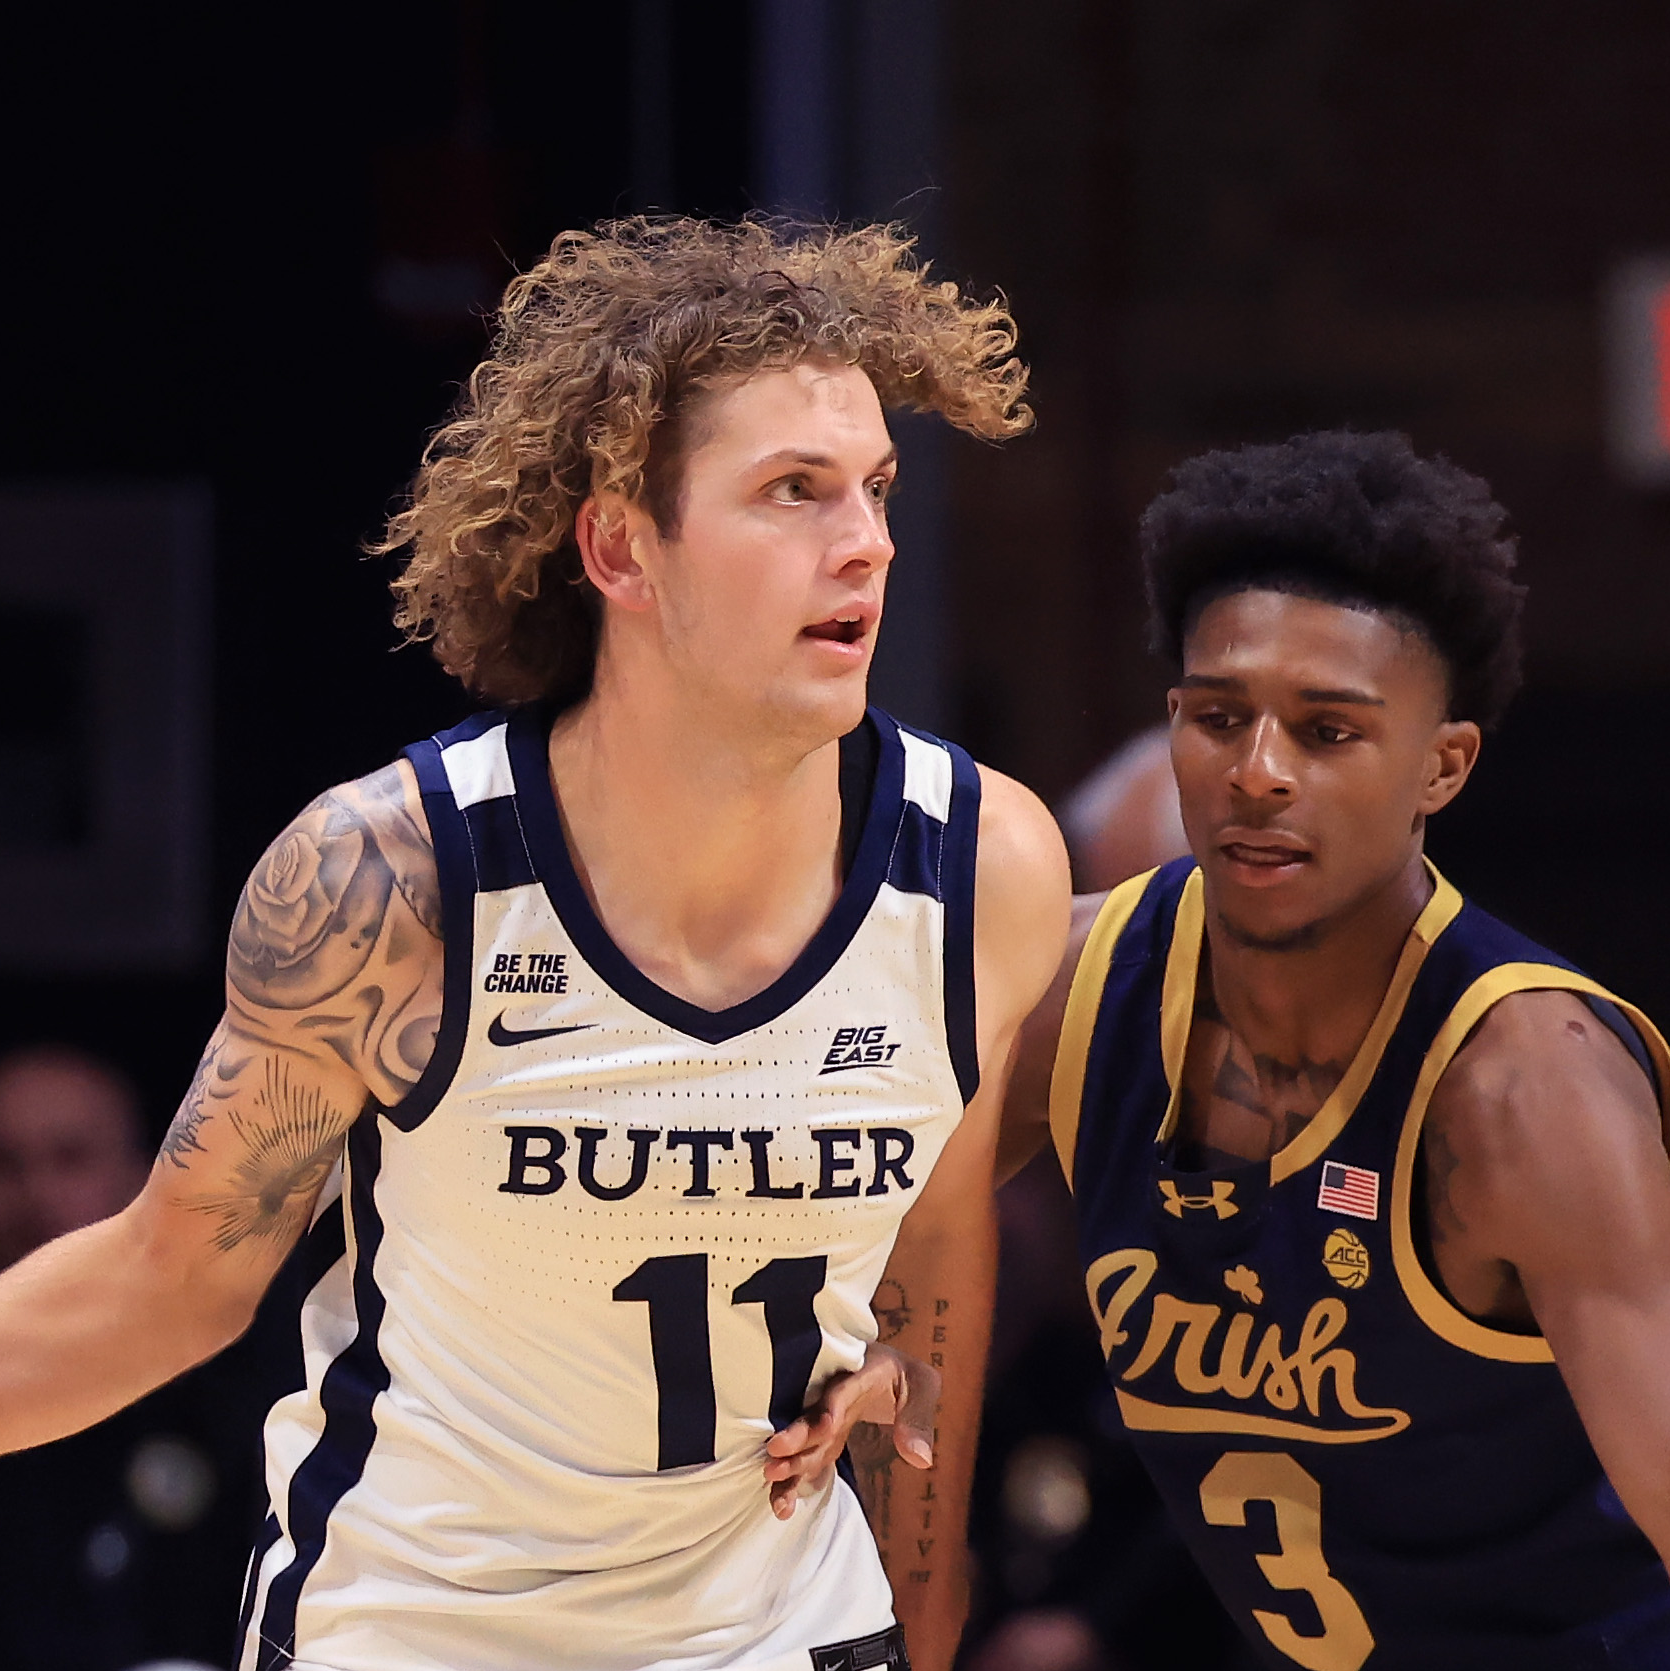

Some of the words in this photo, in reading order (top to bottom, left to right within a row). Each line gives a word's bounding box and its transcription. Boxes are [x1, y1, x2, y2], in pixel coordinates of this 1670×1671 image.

[493, 953, 523, 973] BE
[527, 954, 567, 973] THE
[484, 974, 569, 994] CHANGE
[831, 1025, 888, 1046] BIG
[823, 1043, 901, 1065] EAST
[497, 1126, 915, 1201] BUTLER
[1329, 1246, 1366, 1264] ACC
[1085, 1248, 1411, 1443] Irish
[612, 1252, 828, 1472] 11
